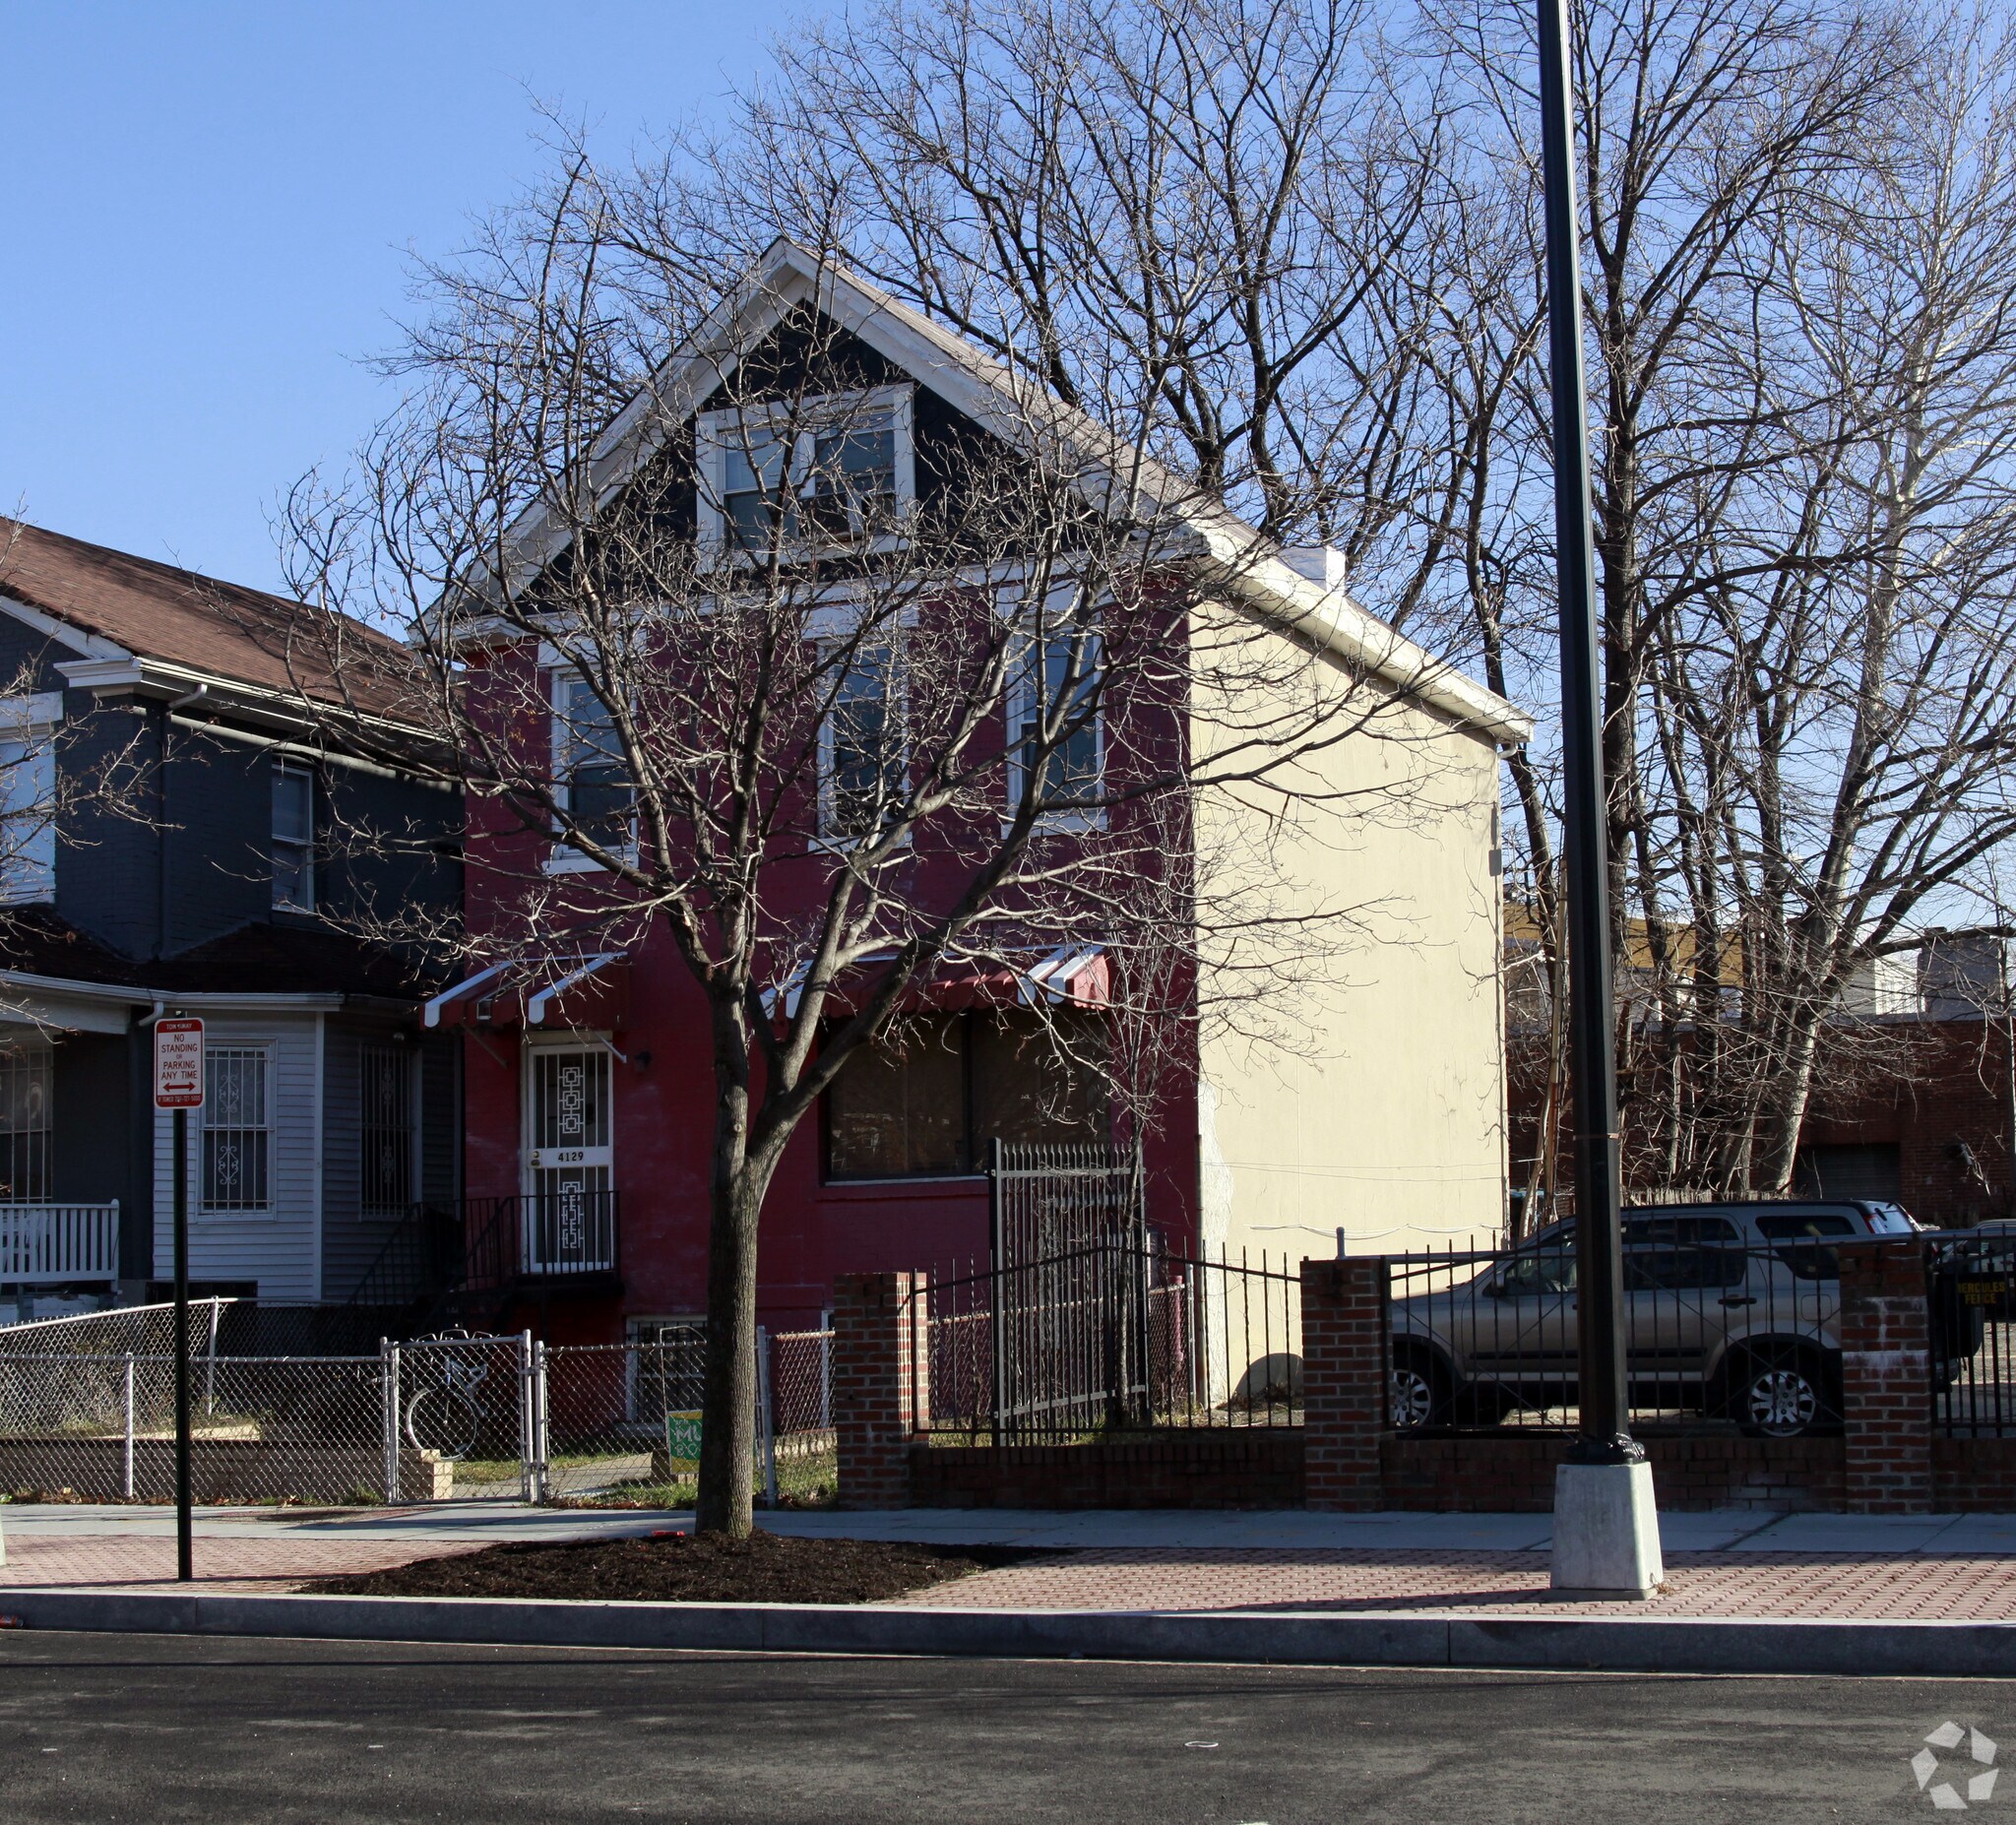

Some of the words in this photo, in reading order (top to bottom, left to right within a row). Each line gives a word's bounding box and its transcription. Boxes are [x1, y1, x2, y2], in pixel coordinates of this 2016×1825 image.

[174, 1034, 185, 1042] NO
[161, 1043, 198, 1053] STANDING
[163, 1060, 195, 1070] PARKING
[161, 1071, 177, 1080] ANY
[181, 1070, 198, 1079] TIME
[558, 1152, 584, 1162] 4129
